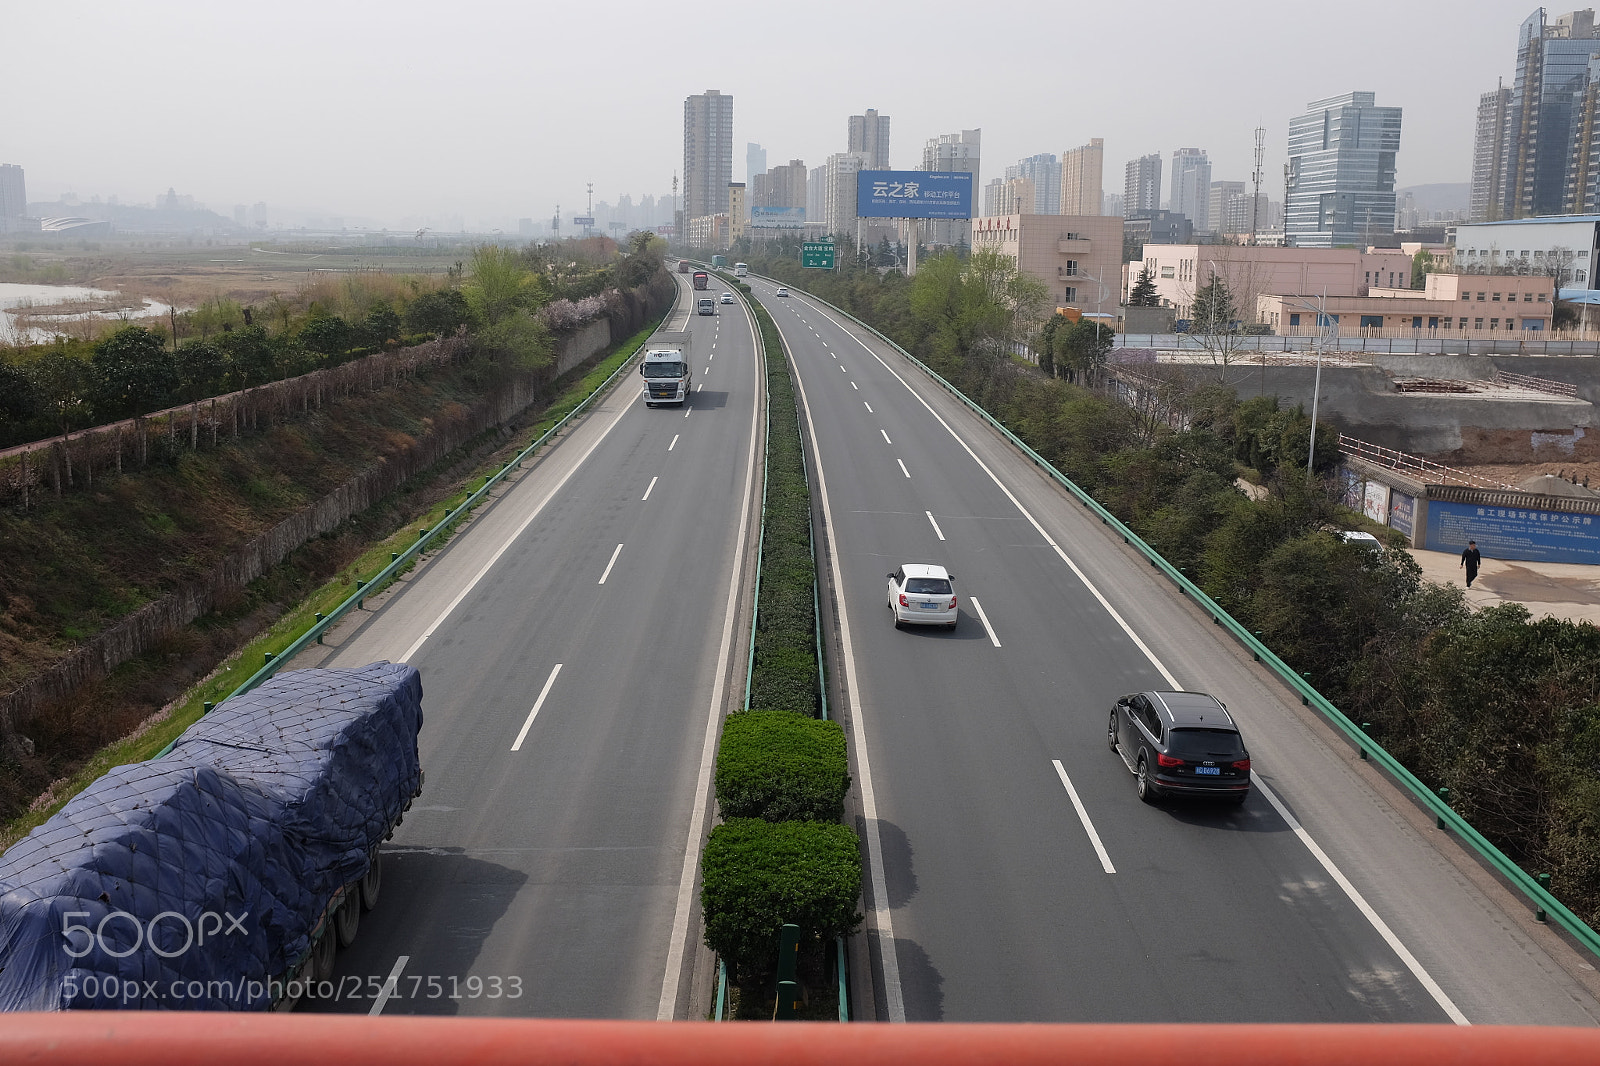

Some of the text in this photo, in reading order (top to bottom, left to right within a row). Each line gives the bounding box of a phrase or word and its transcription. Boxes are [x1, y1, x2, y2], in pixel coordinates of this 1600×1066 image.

[873, 181, 961, 199] 云之家 移动工作平台
[1476, 508, 1593, 526] 施工现场环境保护公示牌
